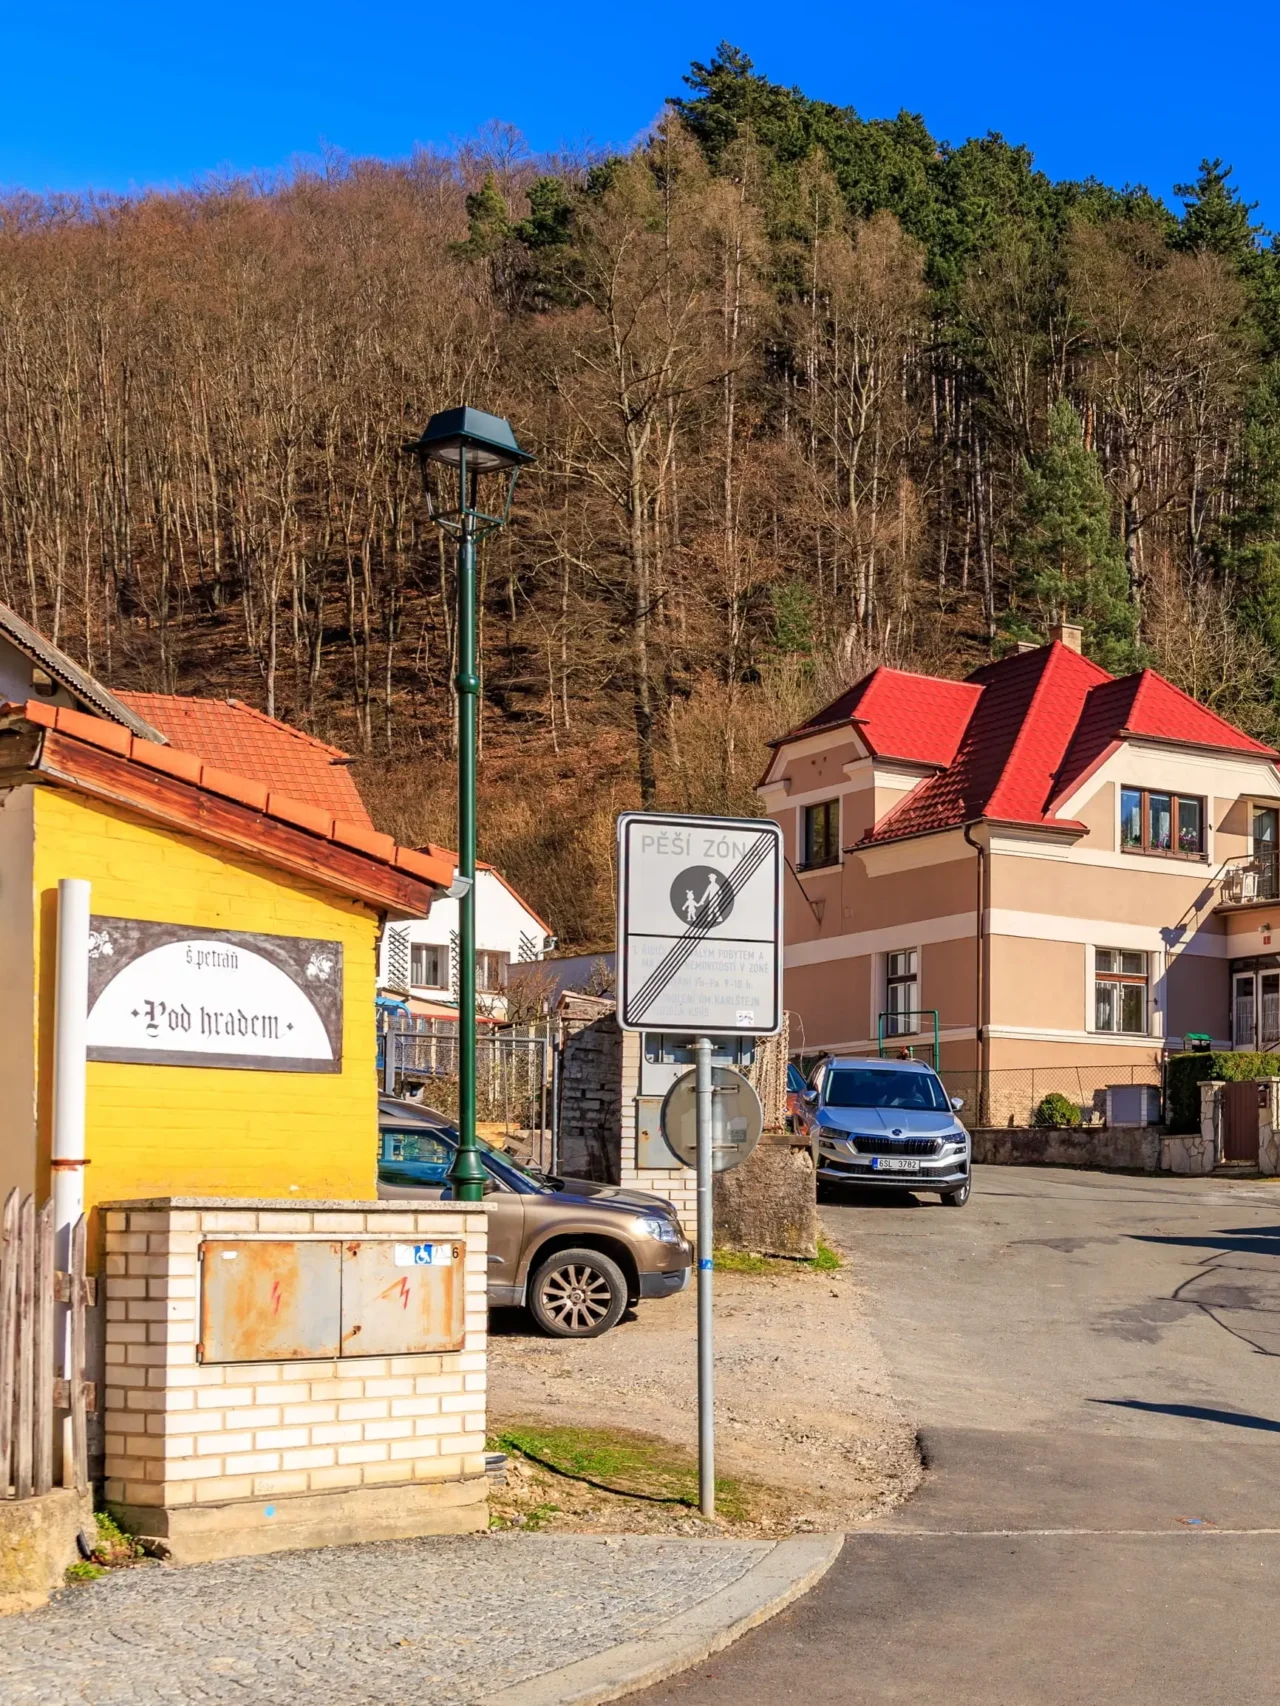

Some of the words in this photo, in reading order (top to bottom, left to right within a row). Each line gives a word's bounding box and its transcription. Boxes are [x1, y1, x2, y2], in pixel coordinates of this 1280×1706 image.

[641, 830, 691, 857] PĚŠÍ
[703, 834, 748, 859] ZÓN
[718, 948, 755, 960] POBYTEM
[758, 951, 764, 960] A
[740, 963, 745, 973] V
[143, 999, 192, 1038] Pod
[200, 1006, 280, 1040] hradem
[879, 1159, 893, 1168] 6SL
[898, 1160, 917, 1169] 3782
[452, 1247, 459, 1259] 6
